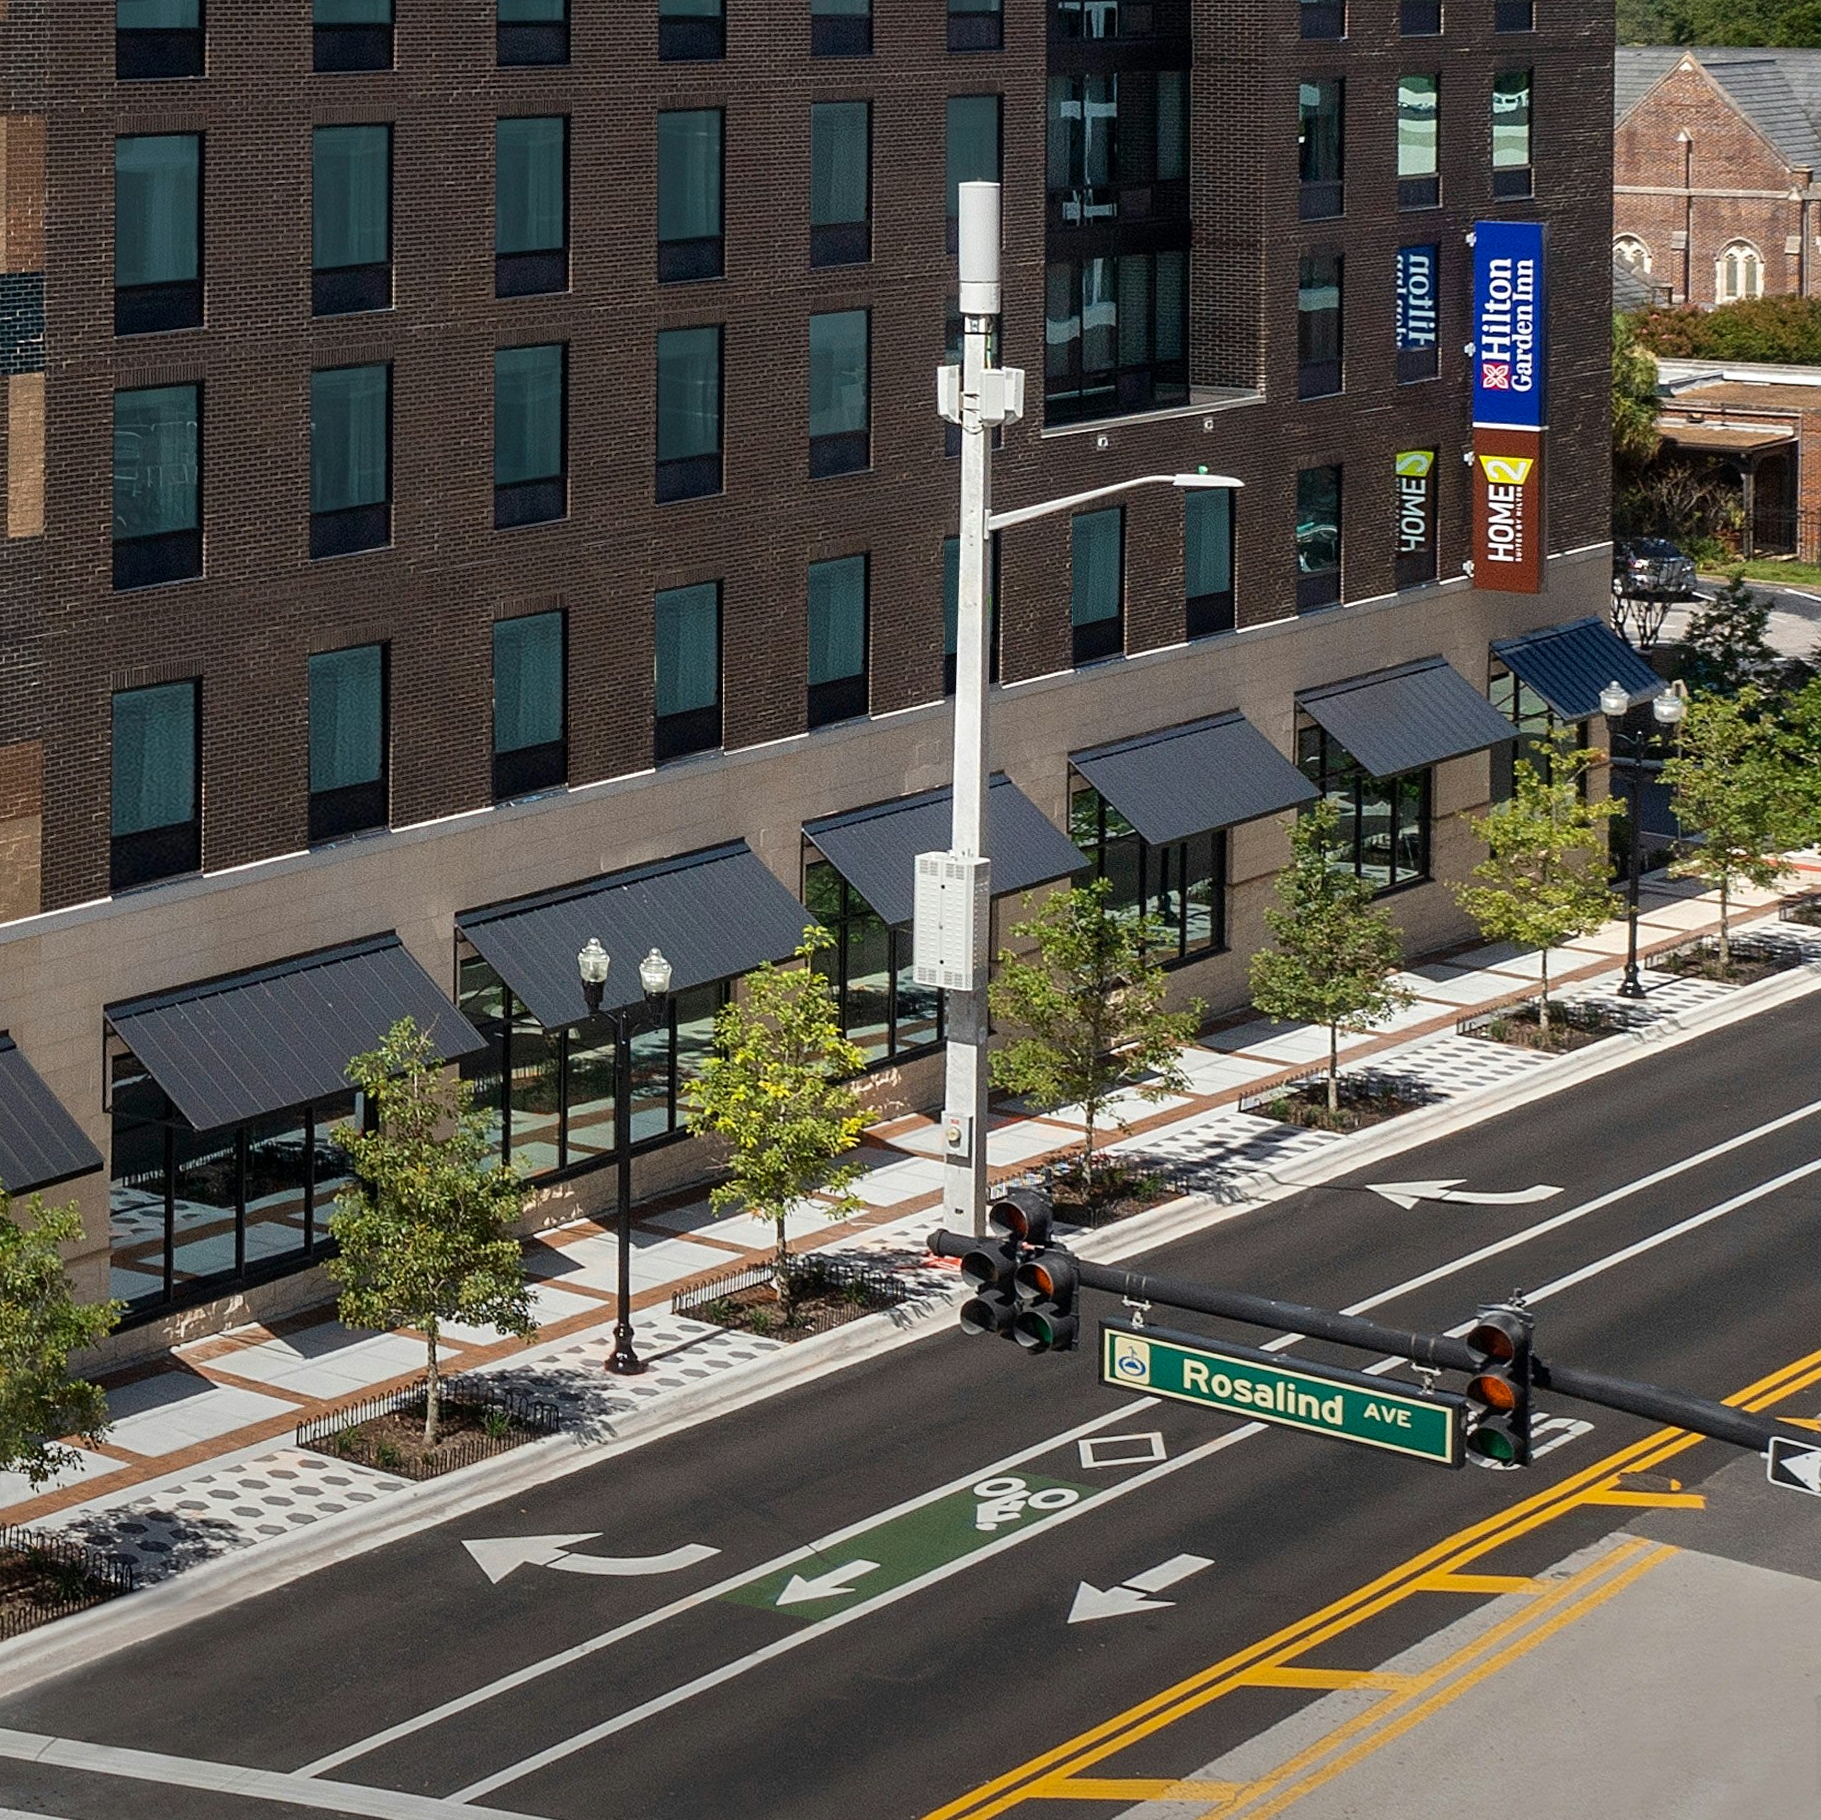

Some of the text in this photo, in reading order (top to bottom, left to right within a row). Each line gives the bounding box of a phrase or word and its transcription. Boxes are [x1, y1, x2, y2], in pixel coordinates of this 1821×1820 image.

[1481, 258, 1512, 362] Hilton
[1511, 259, 1534, 392] Garden Inn
[1486, 460, 1527, 562] HOME 2
[1183, 1358, 1412, 1428] Rosalind AVE
